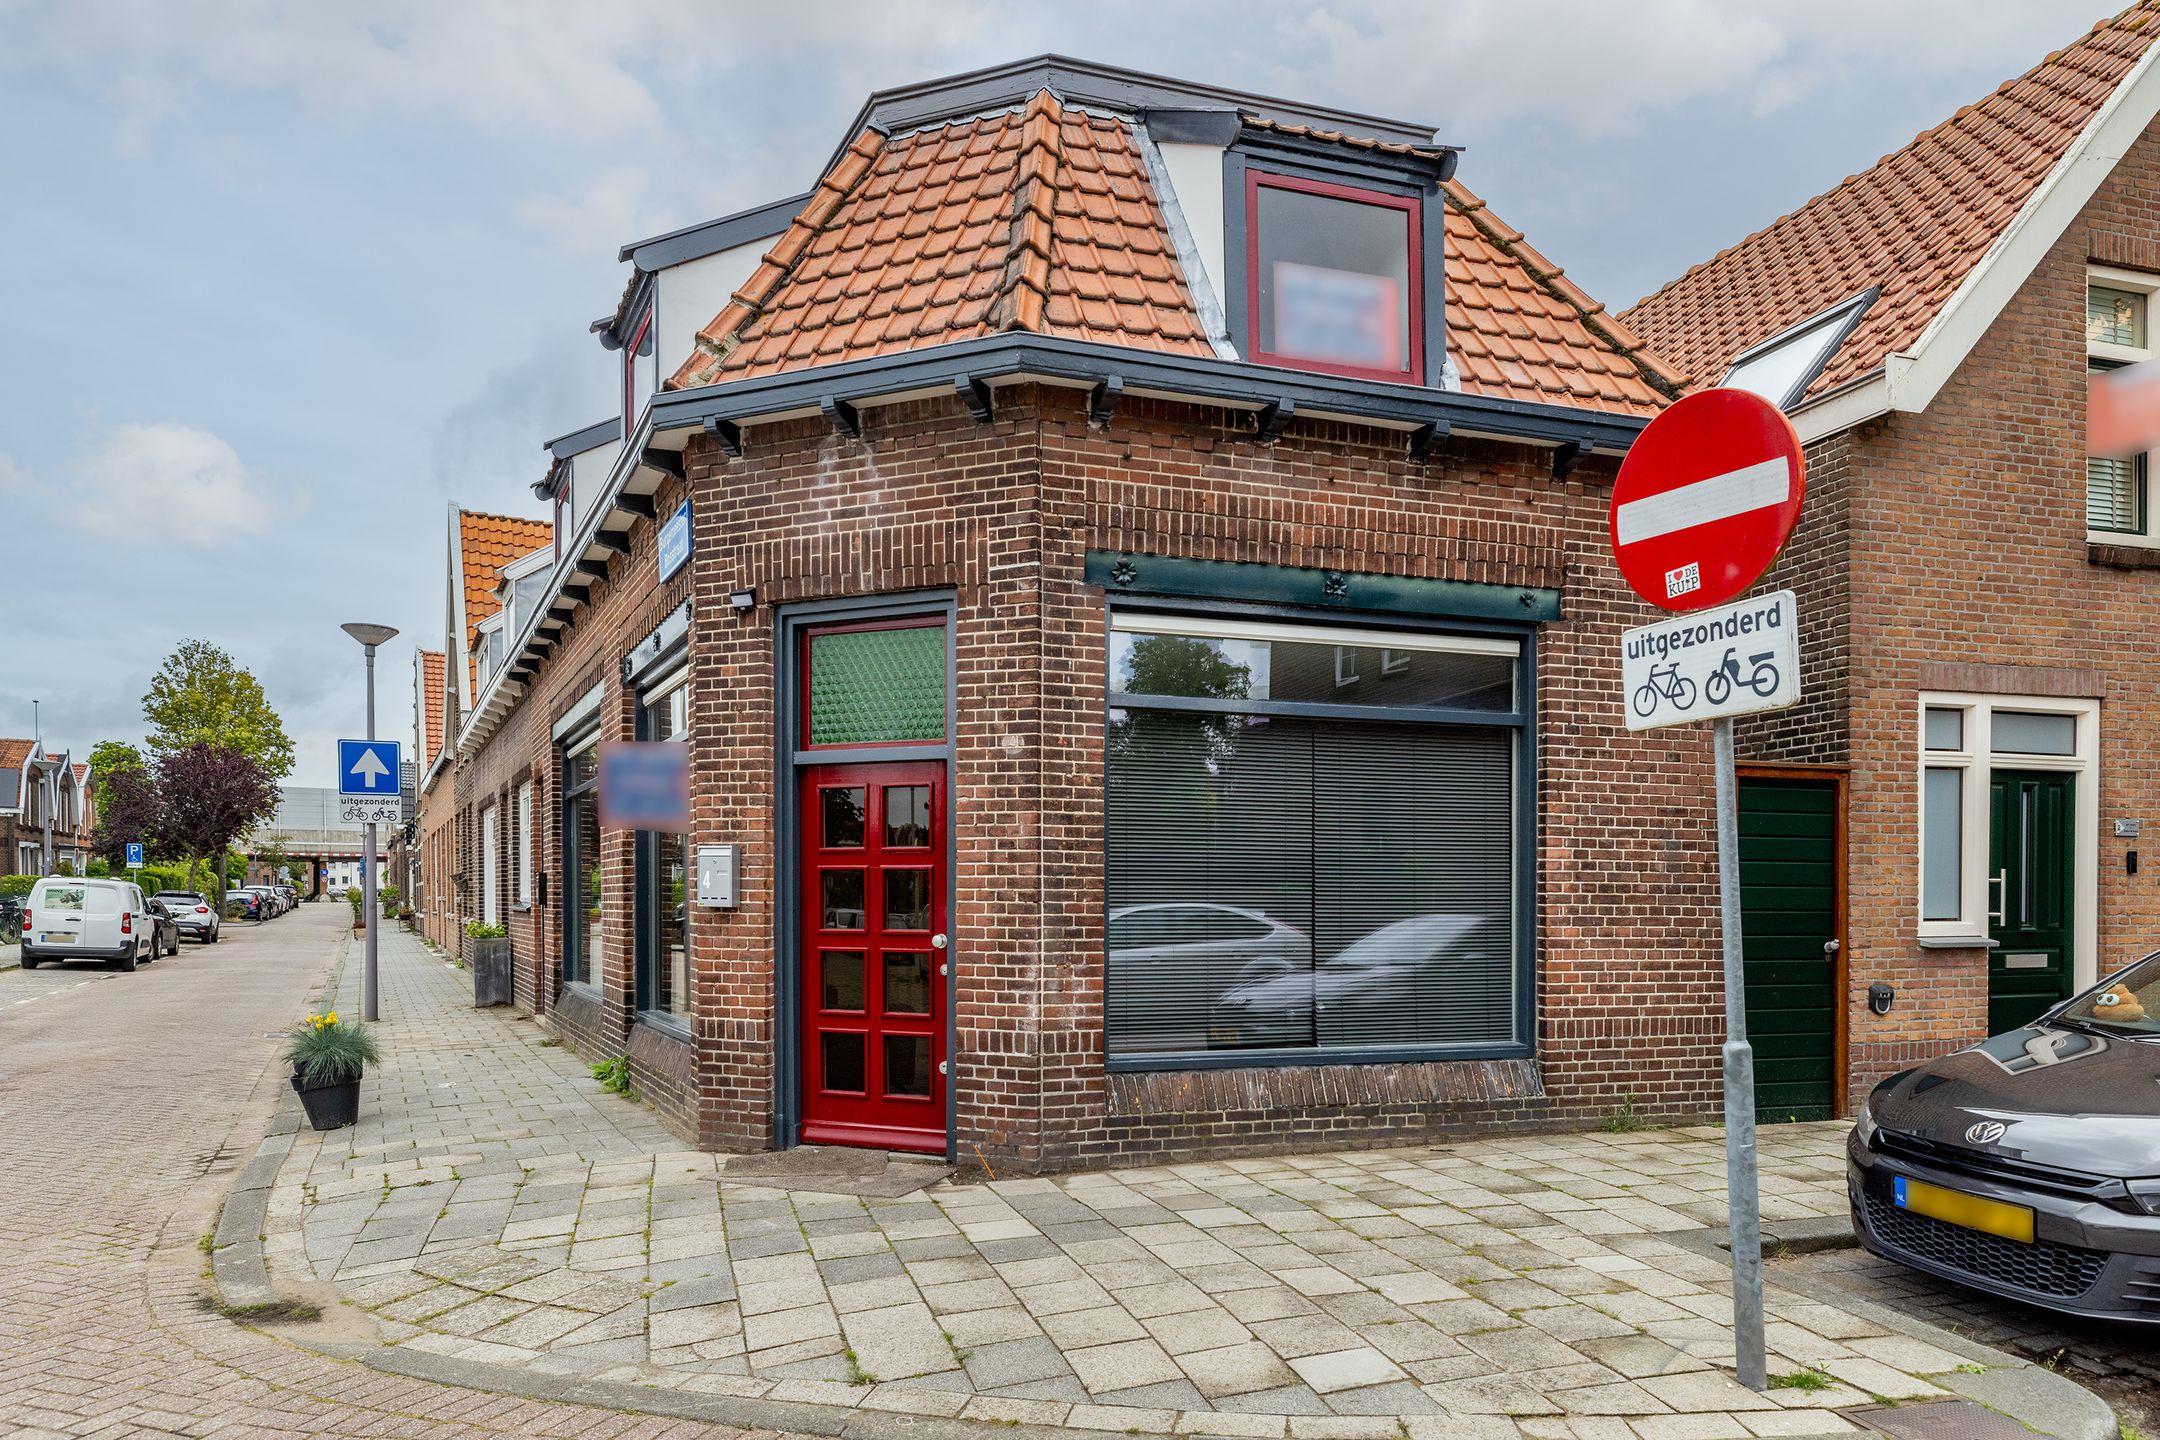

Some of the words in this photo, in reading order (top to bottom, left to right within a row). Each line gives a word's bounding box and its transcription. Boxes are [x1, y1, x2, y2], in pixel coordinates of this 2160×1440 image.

[1685, 565, 1698, 577] DE
[1628, 601, 1781, 661] uitgezonderd
[340, 797, 400, 807] uitgezonderd
[130, 845, 139, 855] P
[702, 870, 711, 889] 4
[1896, 1193, 1905, 1202] NL
